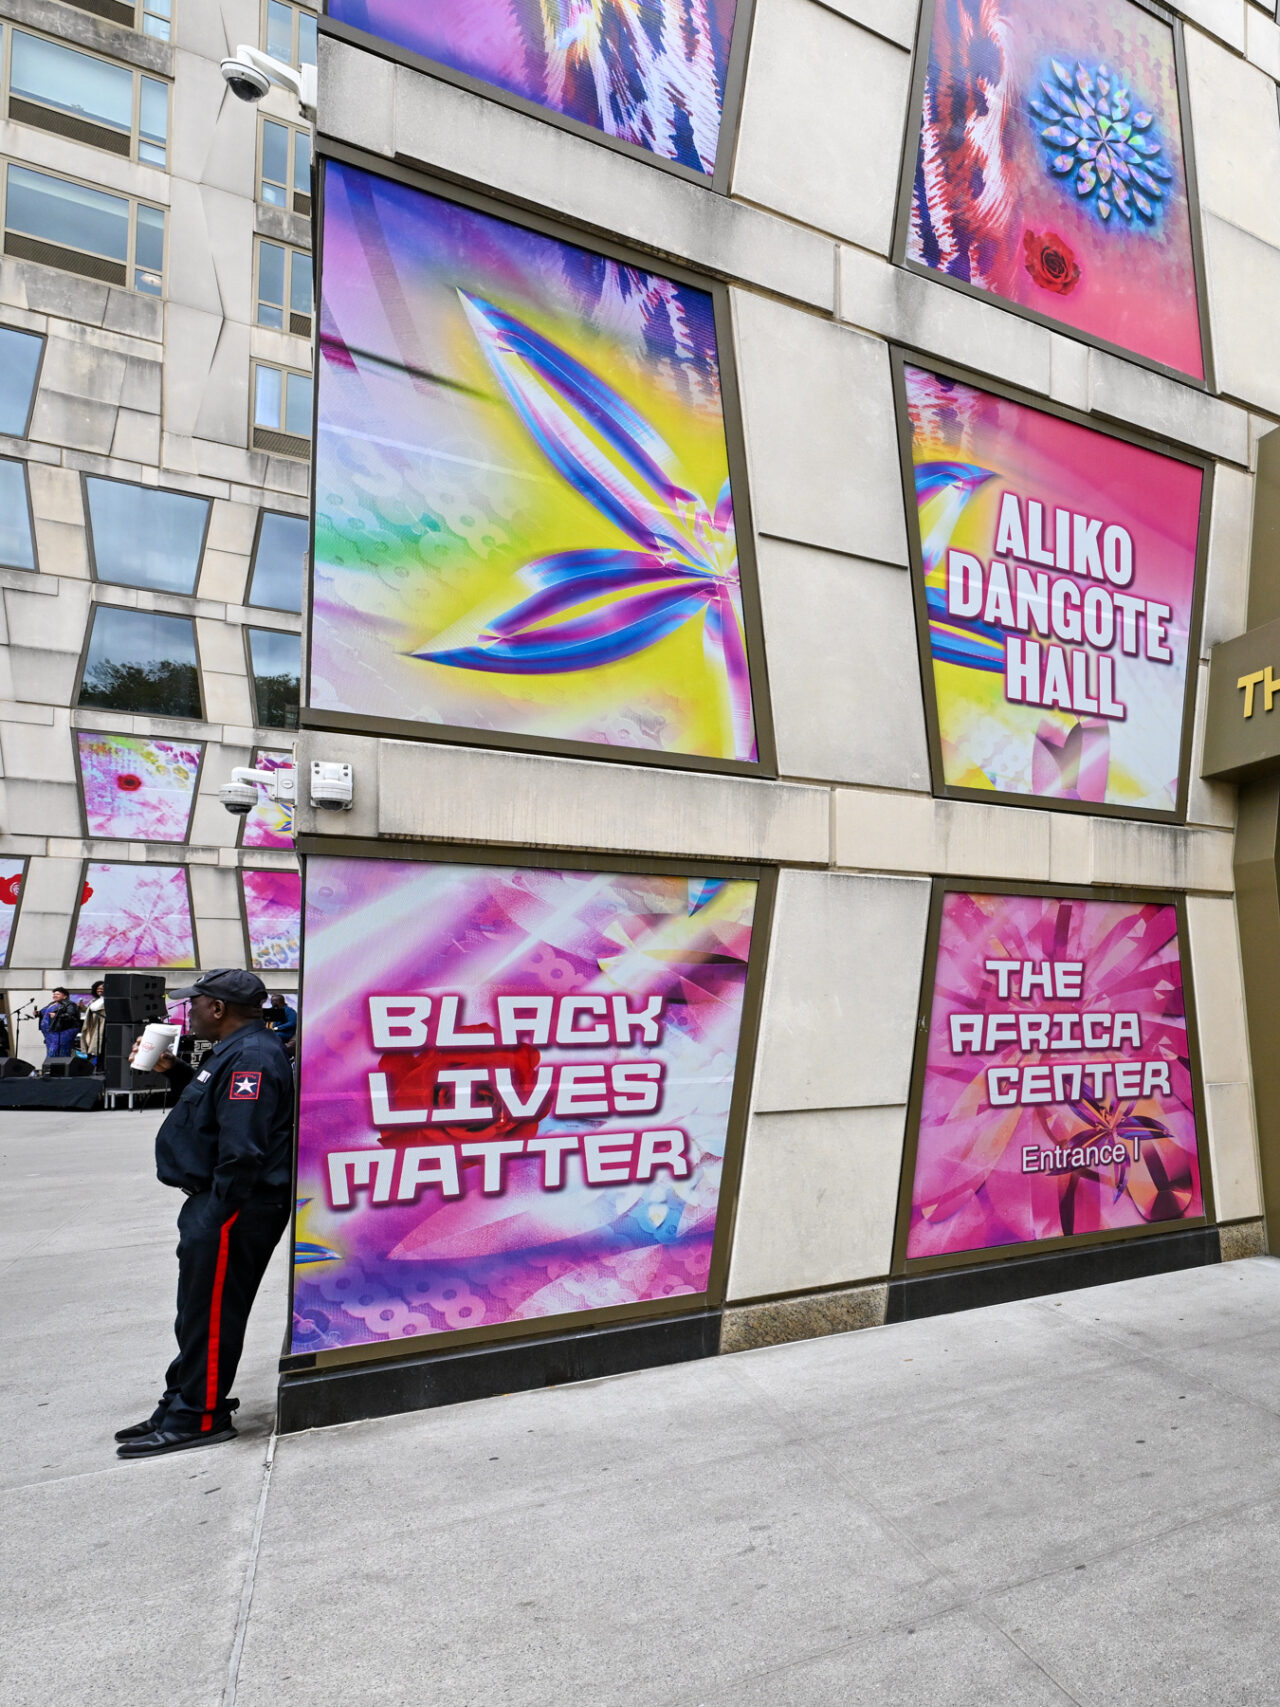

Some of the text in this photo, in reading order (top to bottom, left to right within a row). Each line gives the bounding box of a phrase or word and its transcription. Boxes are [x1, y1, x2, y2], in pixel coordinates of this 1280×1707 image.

[995, 493, 1132, 586] ALIKO
[948, 550, 1173, 662] DANGOTE
[1006, 636, 1125, 719] HALL
[985, 960, 1083, 998] THE
[368, 995, 663, 1049] BLACK
[949, 1013, 1140, 1052] AFRICA
[368, 1063, 661, 1125] LIVES
[987, 1061, 1171, 1105] CENTER
[327, 1129, 689, 1207] MATTER
[1022, 1144, 1126, 1172] Entrance
